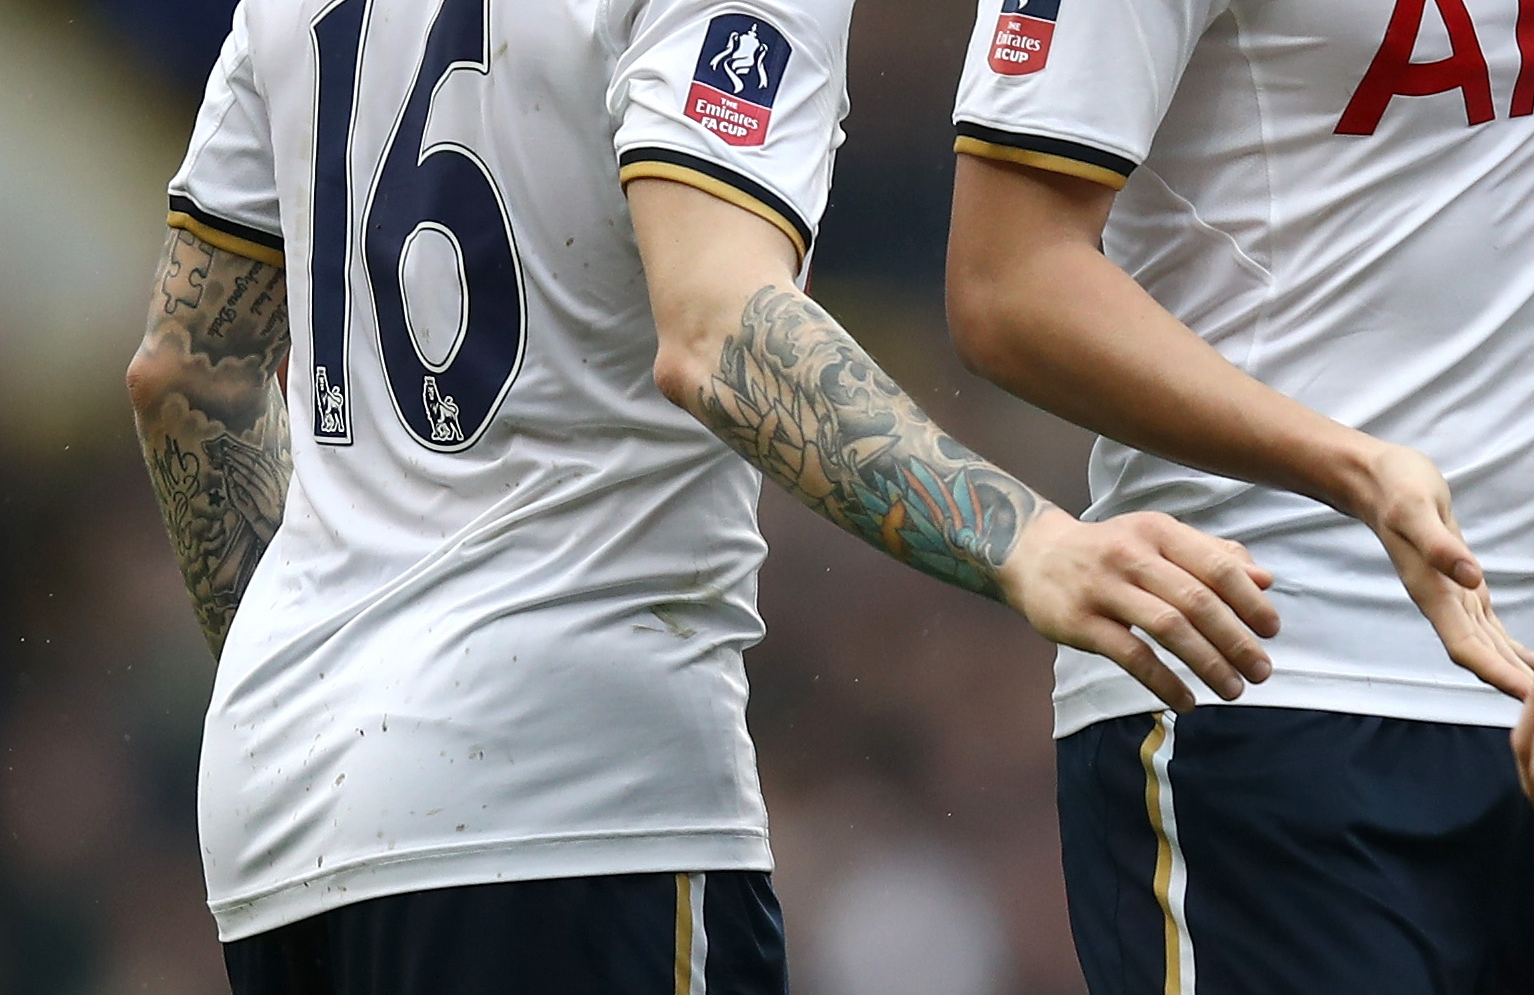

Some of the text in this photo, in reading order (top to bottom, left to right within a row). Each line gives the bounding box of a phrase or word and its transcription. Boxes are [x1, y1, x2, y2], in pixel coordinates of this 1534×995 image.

[1002, 48, 1029, 63] CUP
[720, 97, 738, 109] THE
[695, 99, 759, 129] Emirates
[701, 116, 748, 137] FA CUP
